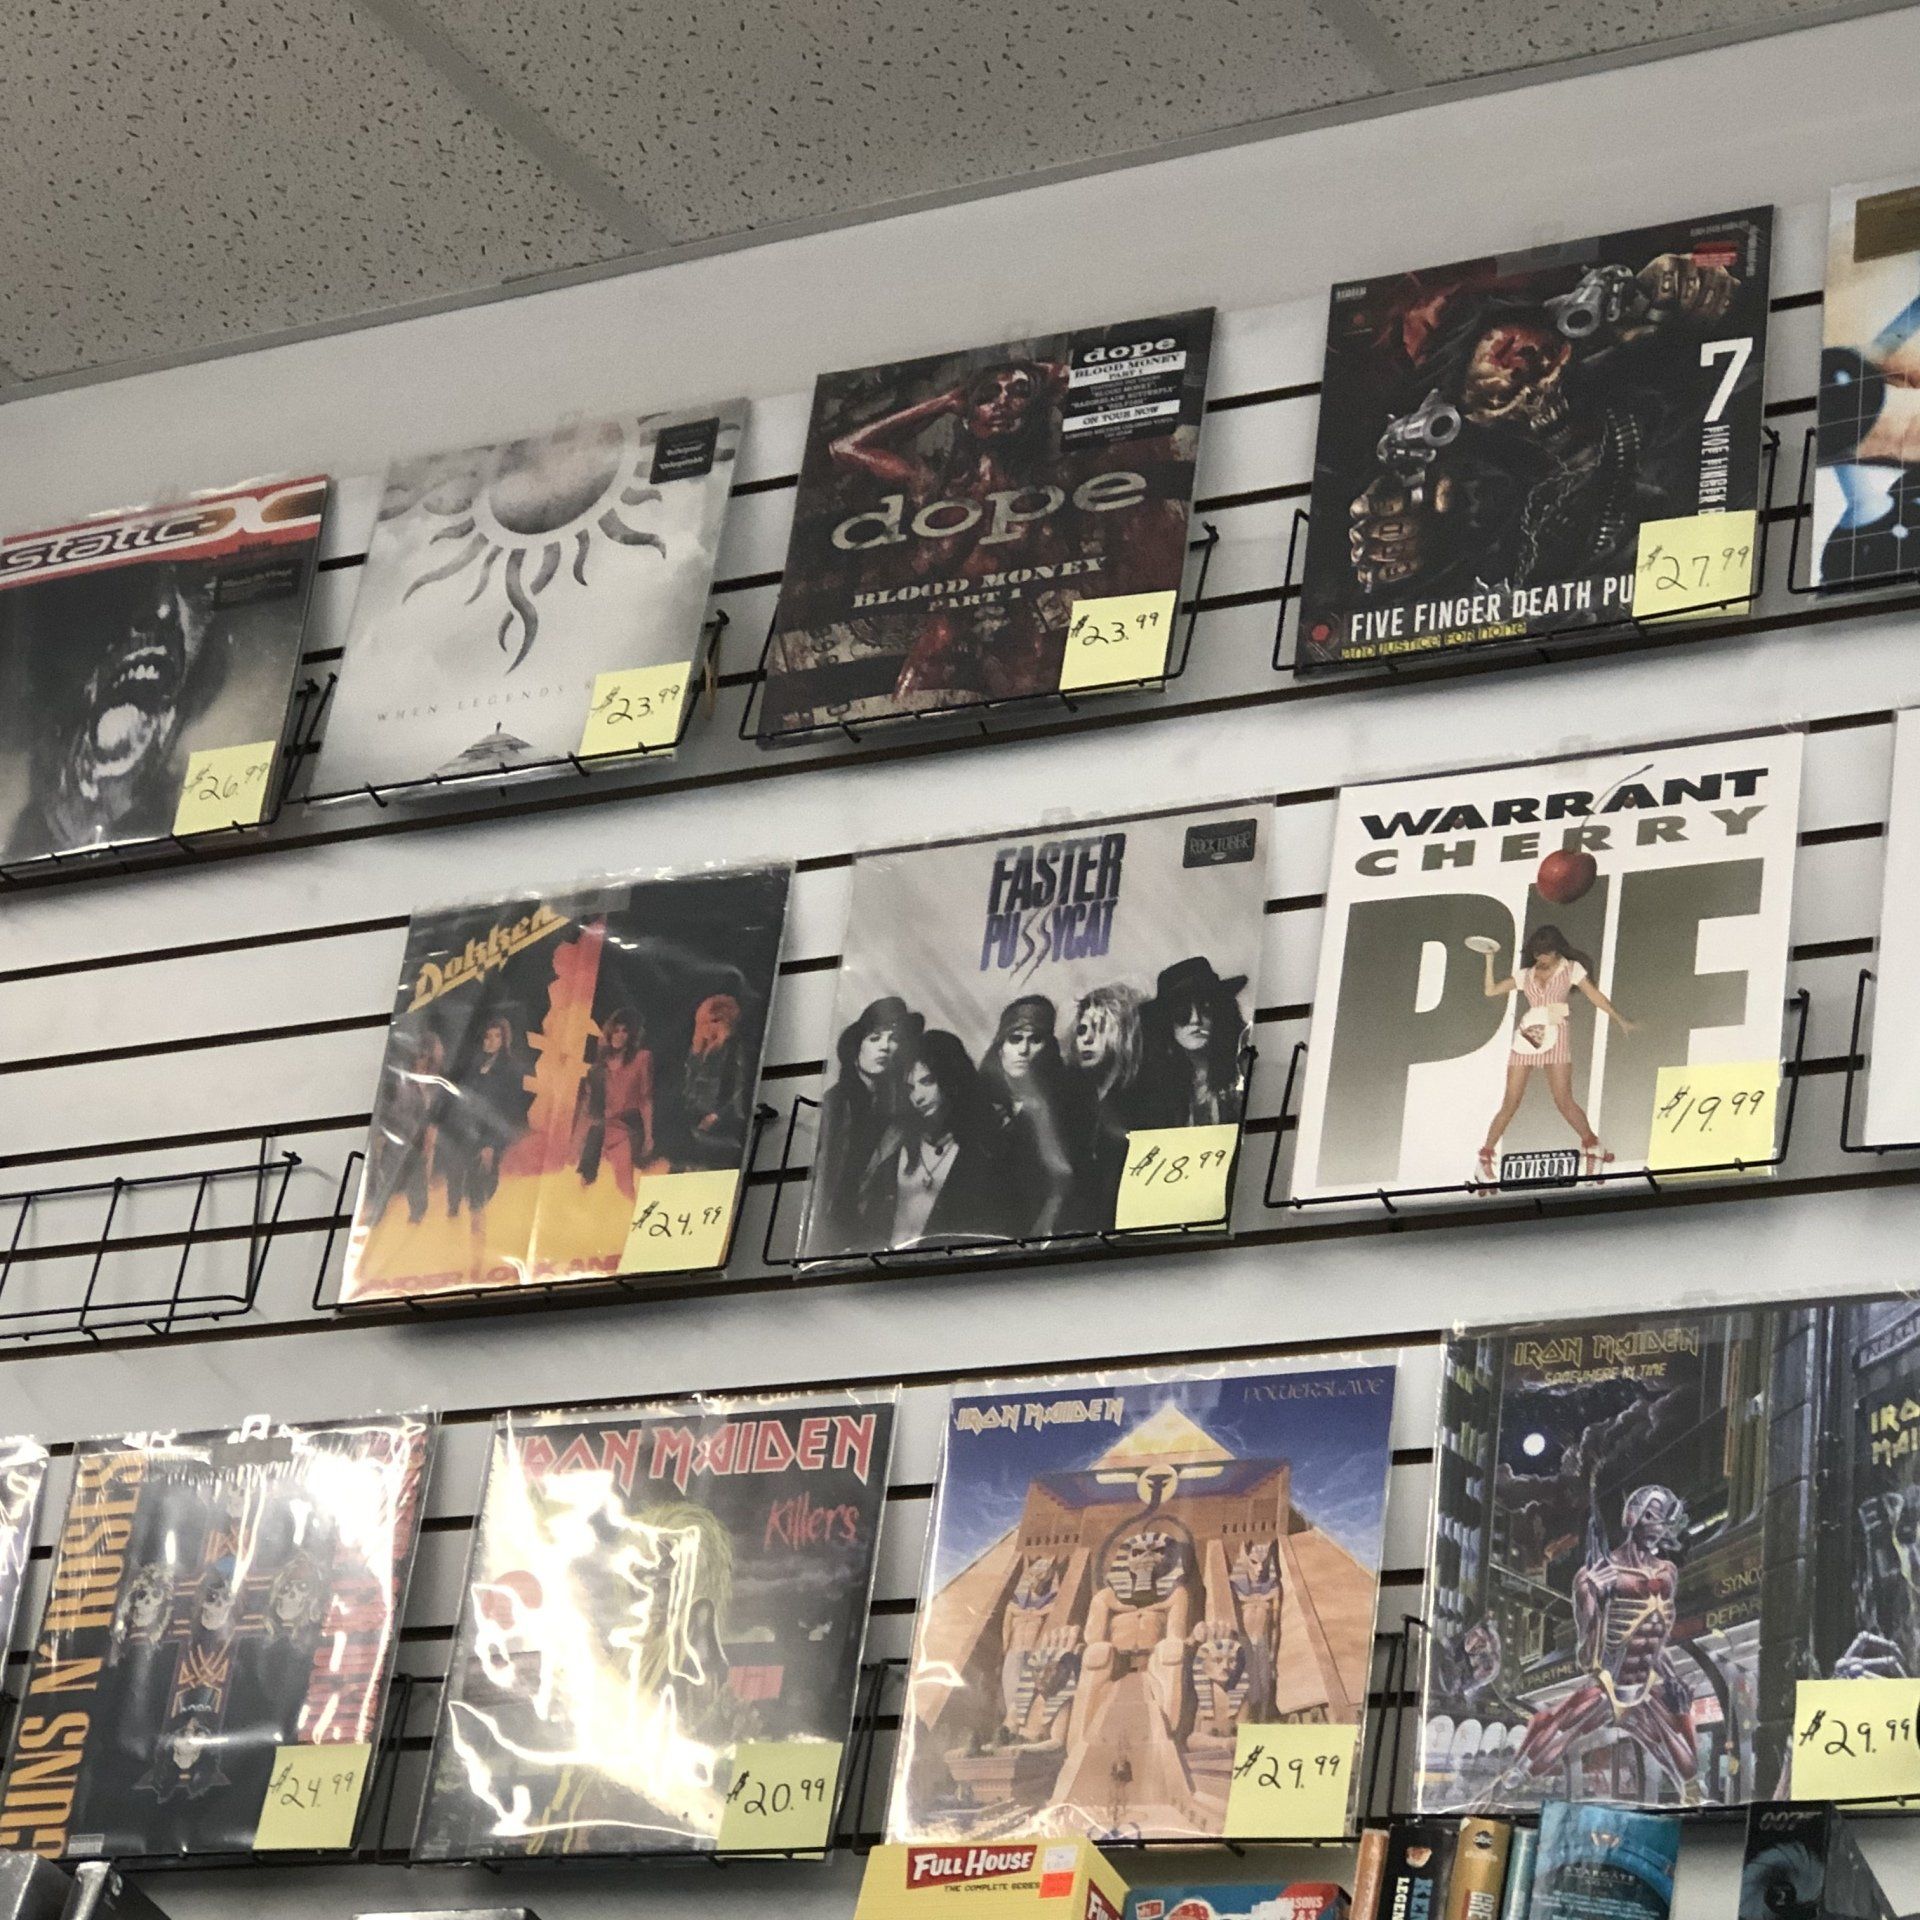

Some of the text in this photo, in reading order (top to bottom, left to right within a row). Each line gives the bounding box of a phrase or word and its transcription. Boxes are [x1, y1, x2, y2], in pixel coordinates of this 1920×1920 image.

[1075, 364, 1124, 379] BLOOD
[1084, 338, 1176, 363] dope
[830, 471, 1148, 551] dope
[852, 556, 1107, 608] BLOOD MONEY
[1638, 545, 1750, 591] $27.99
[927, 590, 1002, 611] PART
[1351, 607, 1404, 642] FIVE
[1414, 593, 1500, 633] FINGER
[1512, 579, 1592, 618] DEATH
[1070, 612, 1159, 646] $23.99
[377, 705, 438, 721] WHEN
[590, 685, 681, 725] $23.99
[184, 762, 268, 800] $26.99
[1360, 768, 1769, 840] WARRANT
[1355, 805, 1768, 877] CHERRY
[987, 832, 1126, 914] FASTER
[407, 905, 571, 1013] Dokken
[979, 898, 1118, 986] PUSSYCAT
[1658, 1085, 1765, 1133] $19.99
[1129, 1146, 1226, 1185] $18.99
[1505, 1159, 1575, 1179] ADVISORY
[632, 1200, 722, 1238] $24.99
[1513, 1326, 1699, 1370] IRON MAIDEN
[956, 1397, 1125, 1436] IRON MAIDEN
[649, 1414, 876, 1497] MAIDEN
[44, 1455, 145, 1632] ROSES
[763, 1491, 859, 1551] Killers
[1799, 1710, 1910, 1757] $29.99
[0, 1710, 91, 1859] GUNS
[270, 1762, 355, 1808] $24.99
[1233, 1745, 1340, 1789] $29.99
[726, 1770, 826, 1816] $20.99
[1759, 1811, 1823, 1831] 007
[913, 1849, 1034, 1881] FULL HOUSE
